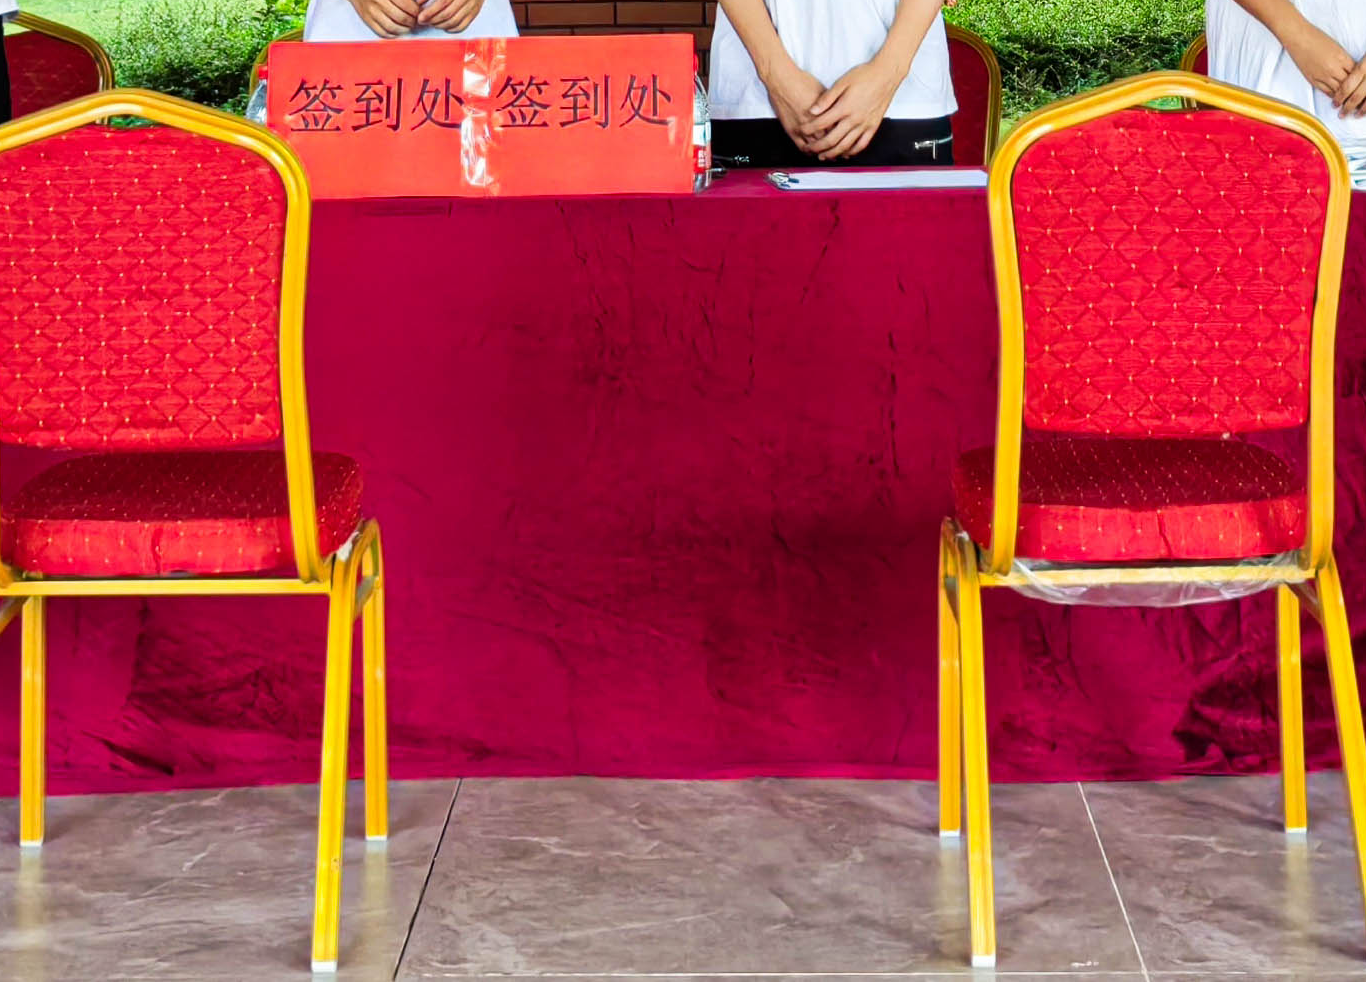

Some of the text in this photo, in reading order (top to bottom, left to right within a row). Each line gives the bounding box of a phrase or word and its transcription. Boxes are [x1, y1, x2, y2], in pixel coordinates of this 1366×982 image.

[288, 74, 672, 132] 签到处 签到处
